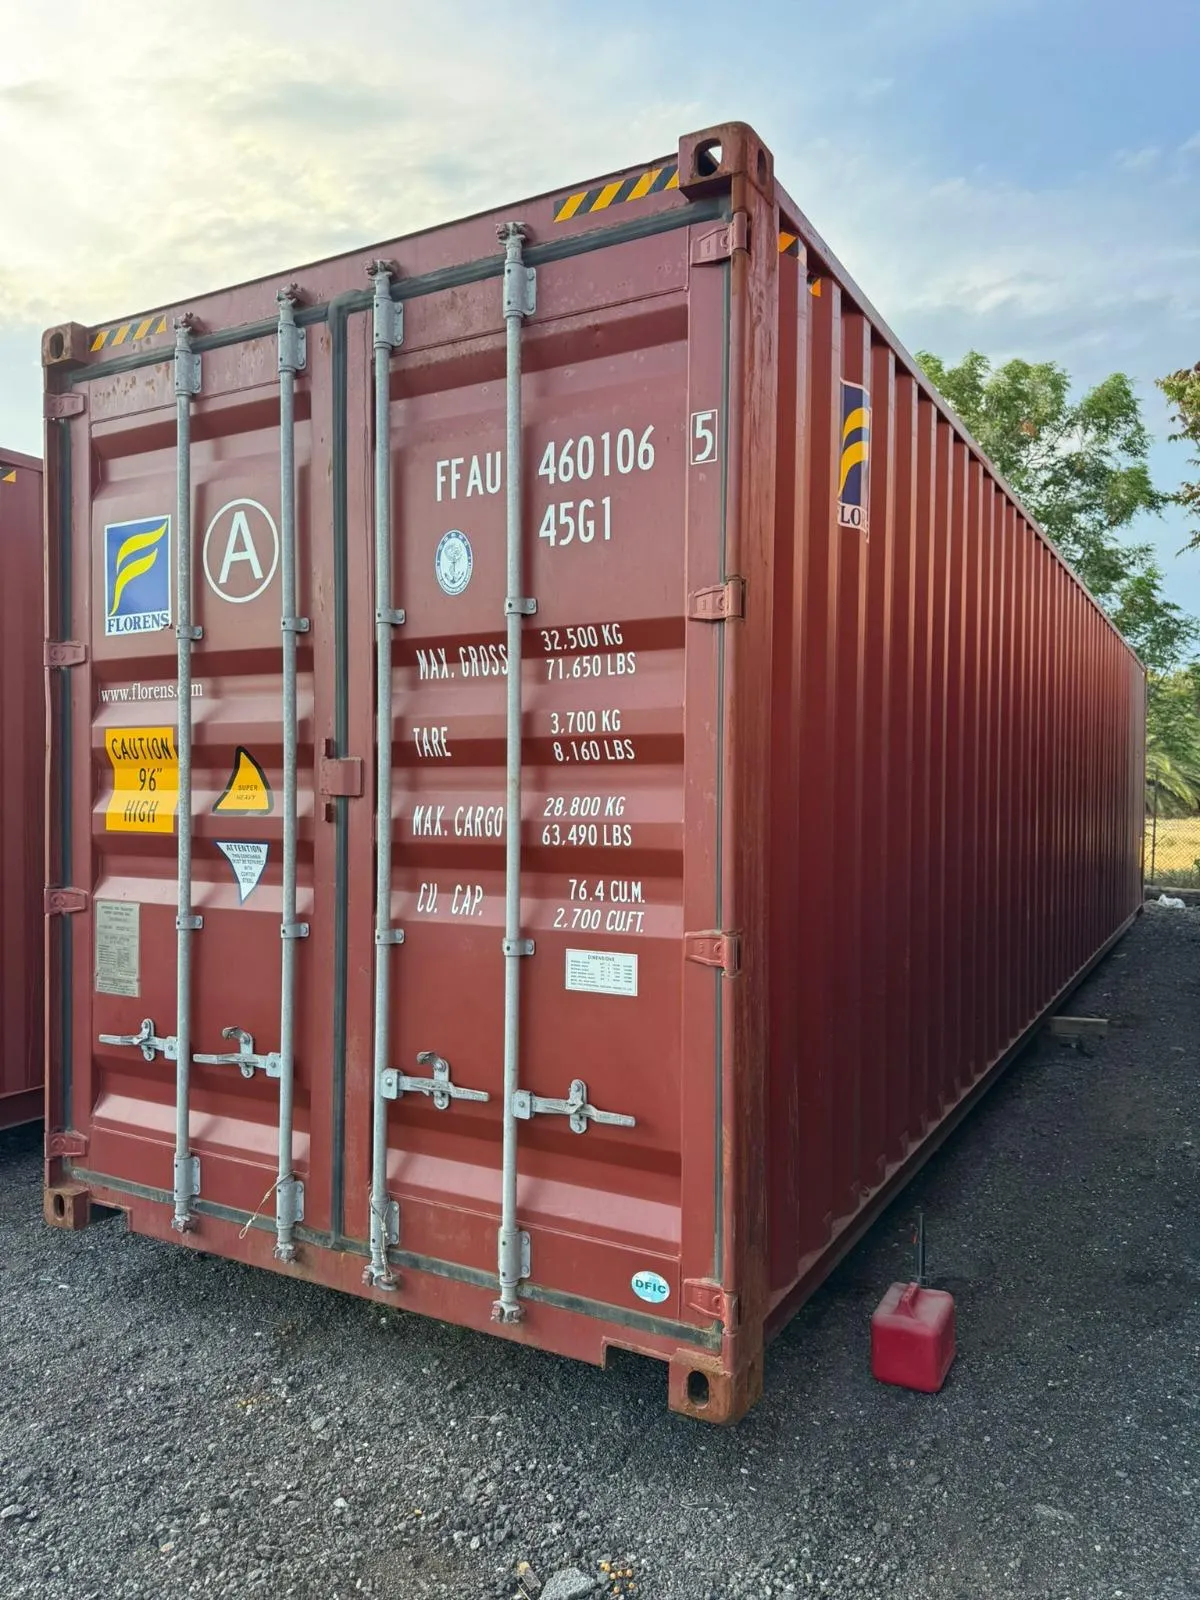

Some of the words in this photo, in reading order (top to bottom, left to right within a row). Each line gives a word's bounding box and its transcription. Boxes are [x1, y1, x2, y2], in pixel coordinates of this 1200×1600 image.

[436, 451, 501, 501] FFAU
[538, 425, 655, 485] 460106
[695, 413, 713, 462] 5
[539, 496, 611, 547] 45G1
[219, 510, 263, 583] A
[107, 612, 169, 633] FLORENS
[540, 626, 598, 651] 32,500
[601, 623, 623, 646] KG
[416, 647, 455, 680] MAX.
[459, 644, 509, 678] GROSS
[546, 655, 601, 680] 71,650
[607, 652, 636, 676] LBS
[550, 710, 597, 734] 3,700
[601, 709, 621, 732] KG
[111, 738, 173, 760] CAUTION
[413, 727, 452, 757] TARE
[553, 740, 601, 762] 8,160
[603, 739, 635, 761] LBS
[124, 800, 159, 823] HIGH
[543, 797, 601, 817] 28,800
[604, 796, 626, 817] KG
[412, 805, 448, 836] MAX.
[454, 806, 504, 837] CARGO
[542, 824, 598, 846] 63,490
[603, 825, 632, 847] LBS
[226, 844, 262, 853] ATTENTION
[417, 883, 438, 913] CU.
[451, 884, 484, 916] CAP.
[569, 879, 605, 901] 76.4
[610, 880, 646, 904] CU.M.
[553, 908, 601, 929] 2,700
[605, 909, 645, 933] CU.FT.
[635, 1279, 666, 1294] DFIC
